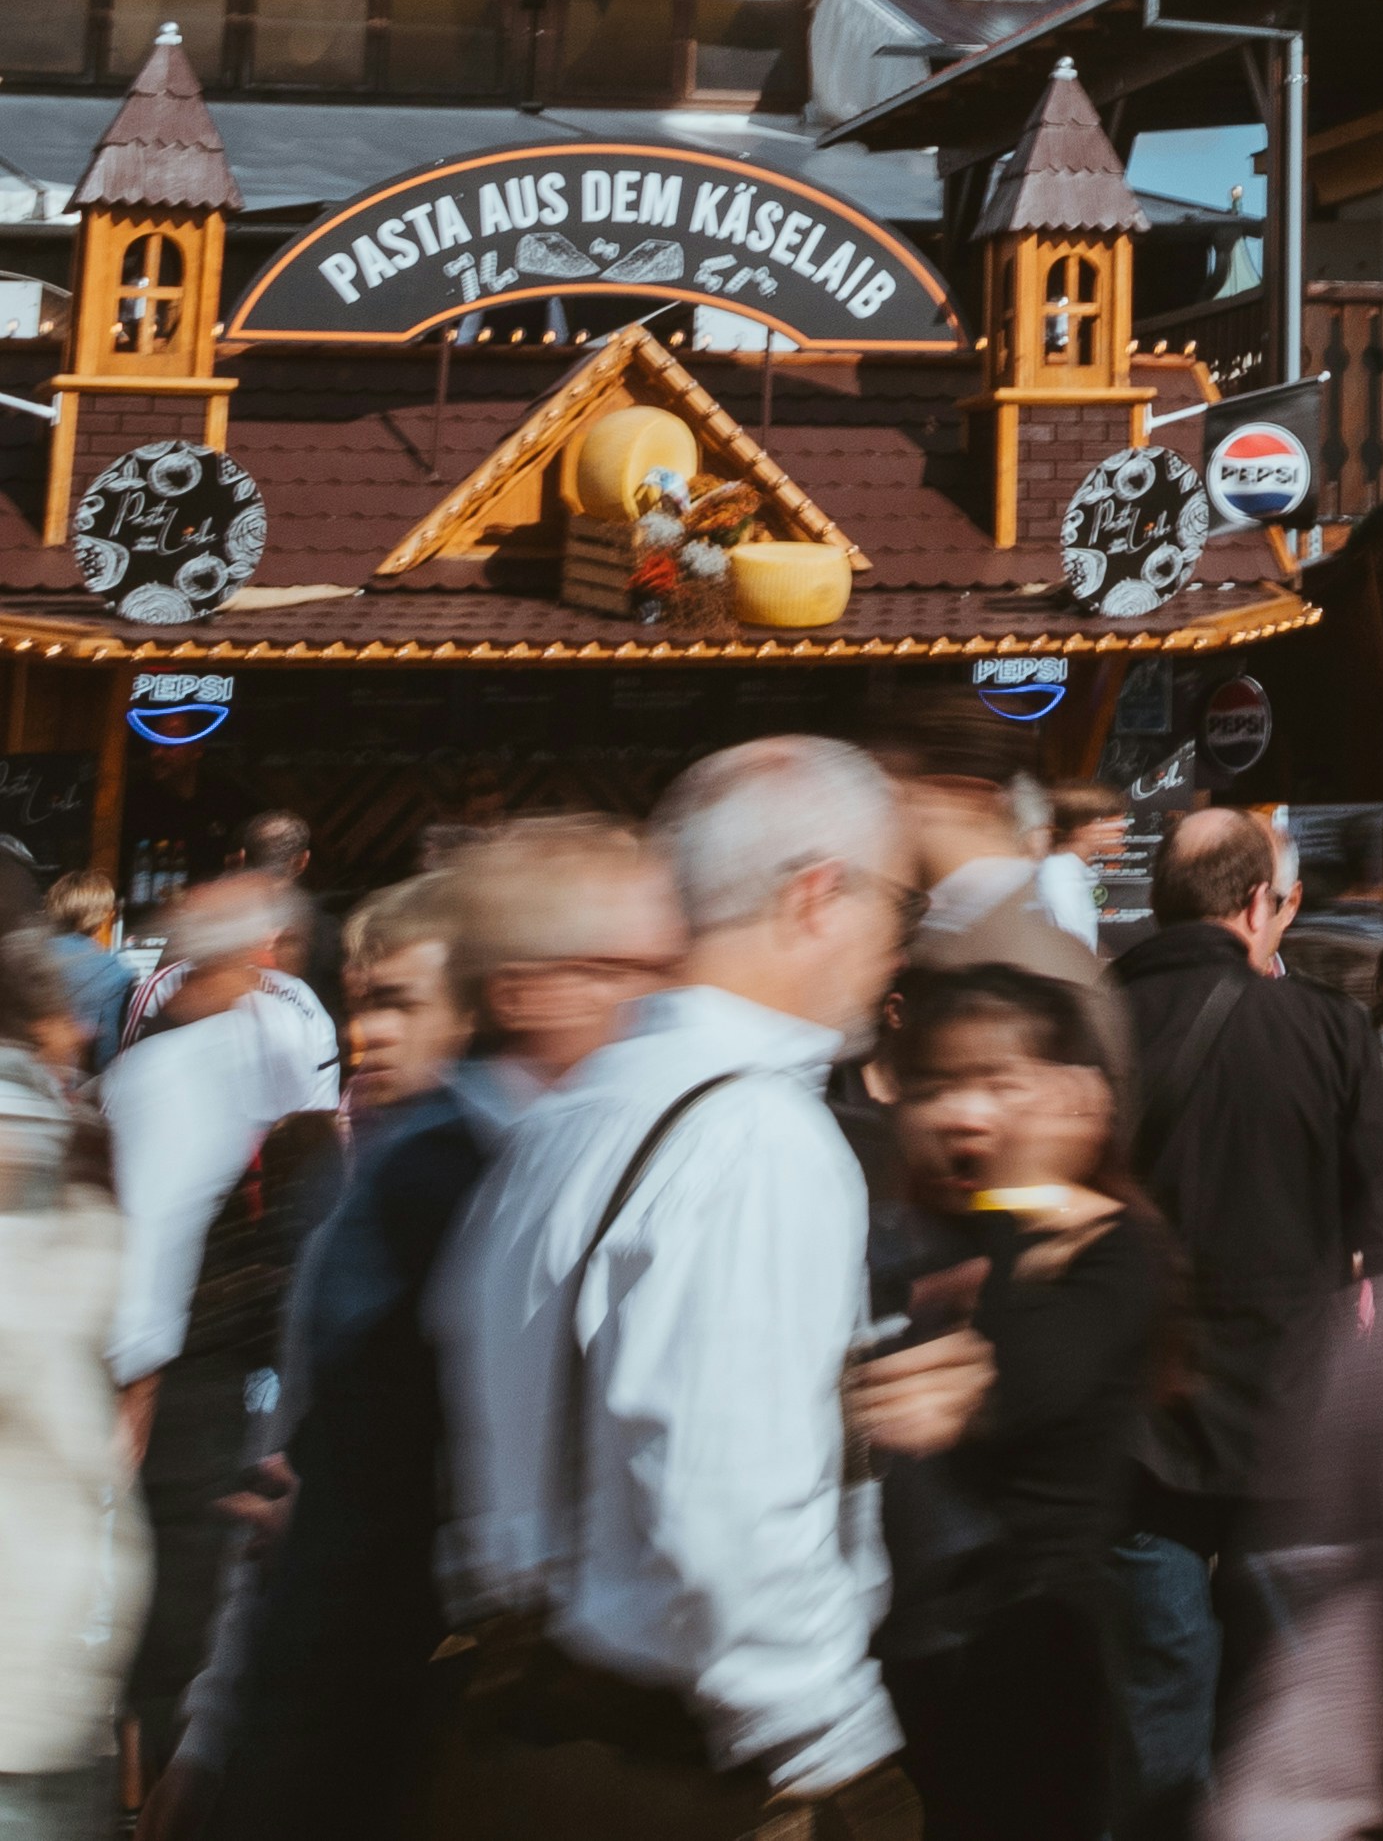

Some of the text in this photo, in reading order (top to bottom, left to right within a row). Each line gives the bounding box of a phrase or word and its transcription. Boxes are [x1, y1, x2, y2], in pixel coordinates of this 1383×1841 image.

[318, 170, 898, 319] PASTA AUS DEM KÄSELAIB
[1221, 465, 1300, 485] PEPSI
[974, 657, 1068, 684] PEPSI
[130, 674, 235, 702] PEPSI
